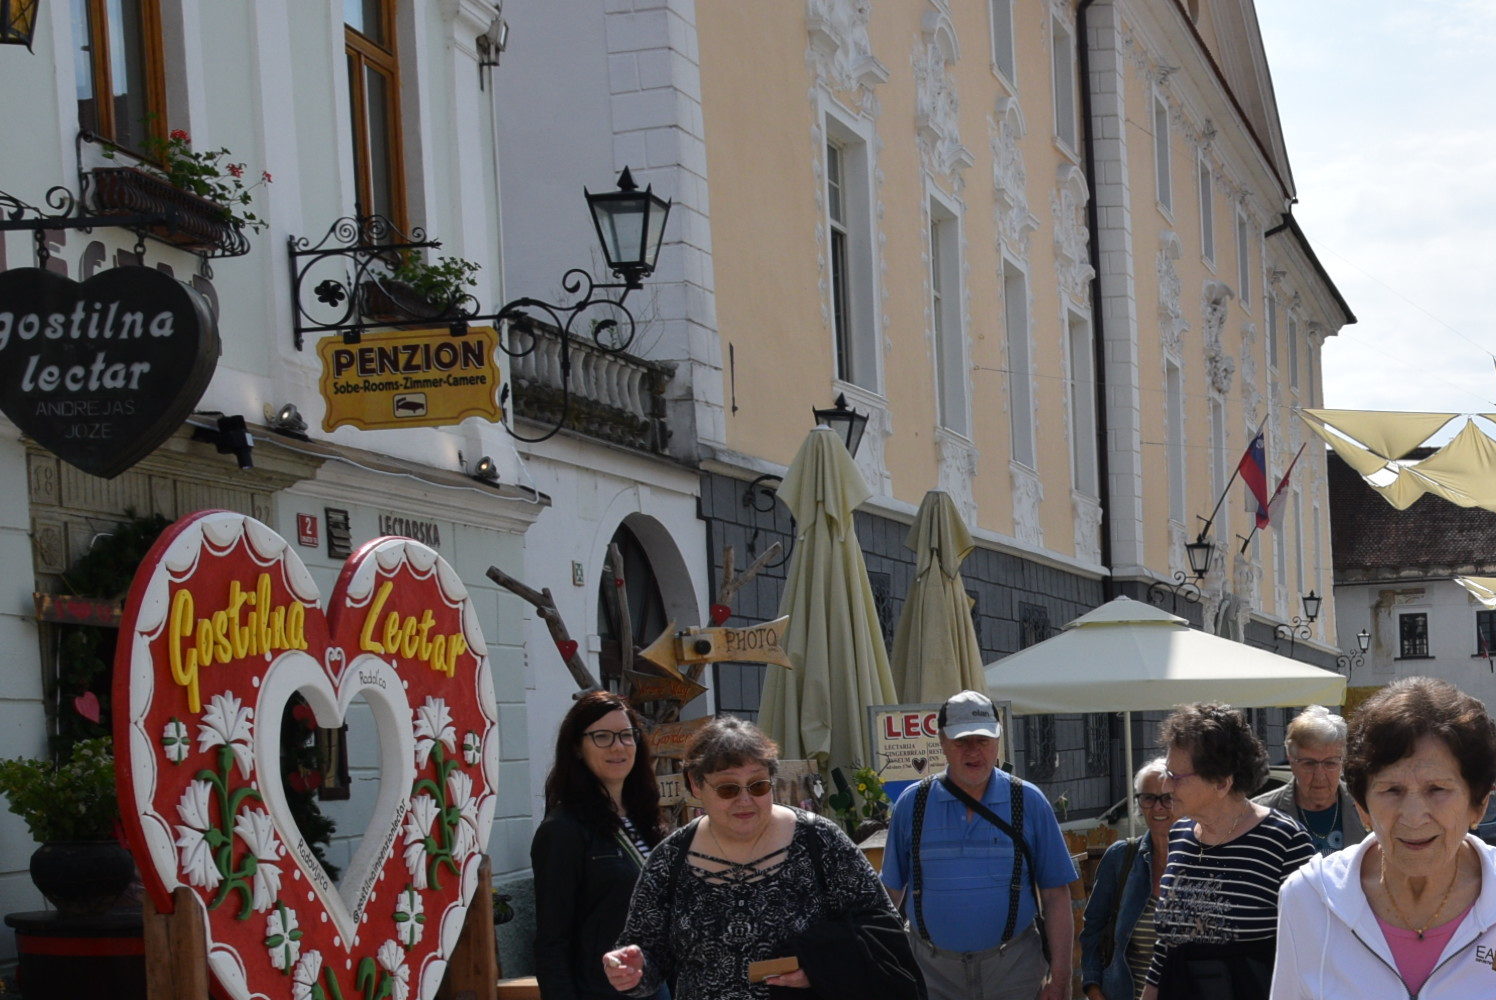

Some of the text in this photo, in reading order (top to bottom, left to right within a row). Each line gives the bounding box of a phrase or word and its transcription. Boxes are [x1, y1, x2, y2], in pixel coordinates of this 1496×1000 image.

[0, 300, 175, 350] gostilna
[21, 351, 151, 392] lectar
[332, 340, 486, 379] PENZION
[333, 374, 487, 395] Sobe-Rooms-Zimmer-Camere
[304, 517, 313, 535] 2
[379, 515, 440, 547] LECTARSKA
[169, 573, 308, 713] Gostilna
[360, 581, 466, 678] Lectar
[726, 628, 778, 652] PHOTO
[884, 712, 939, 741] LEC
[972, 708, 990, 718] elan
[650, 727, 690, 747] Garde
[1476, 945, 1495, 961] EA
